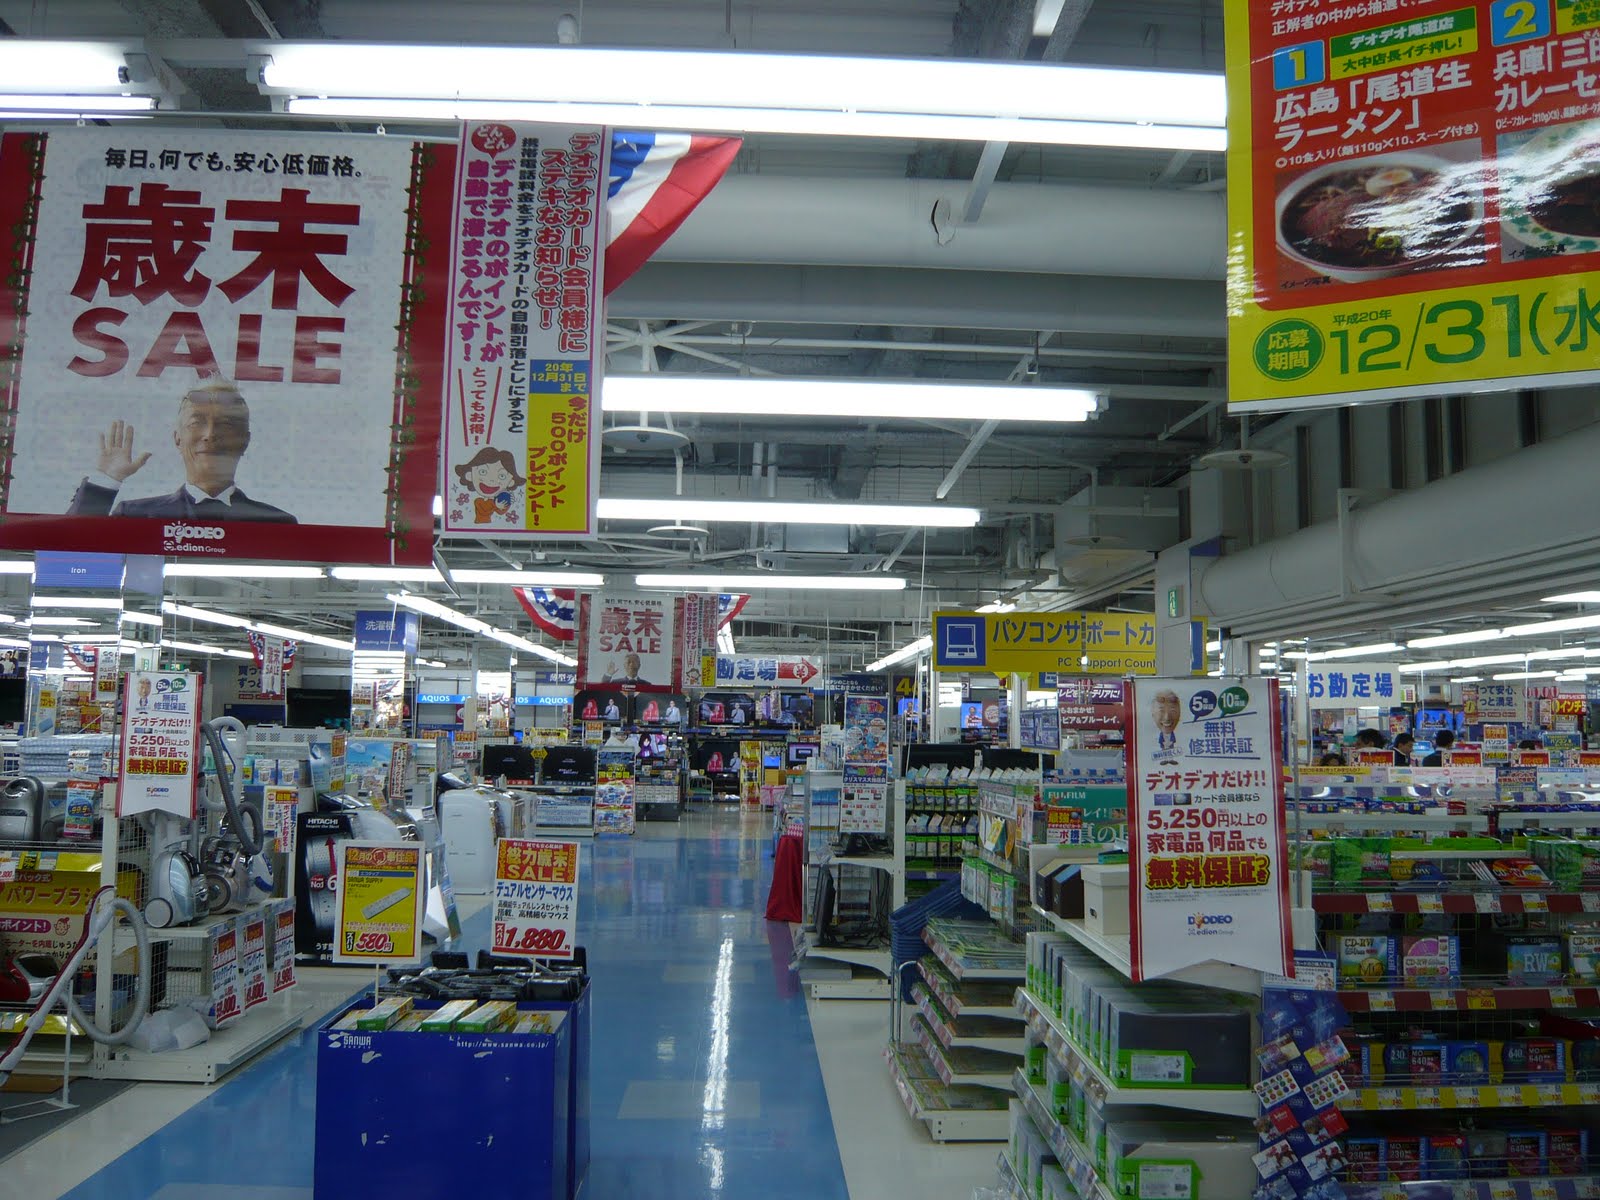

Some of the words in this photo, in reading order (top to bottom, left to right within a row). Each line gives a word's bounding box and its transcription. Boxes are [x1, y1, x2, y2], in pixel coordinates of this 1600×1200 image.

[1504, 1, 1537, 38] 2
[1350, 17, 1454, 50] デオデオ尾道店
[1289, 49, 1306, 81] 1
[1274, 61, 1472, 124] 広島「尾道生
[1495, 70, 1600, 112] カレーセ
[1275, 100, 1420, 152] ラーメン」
[70, 183, 361, 311] 歳末
[533, 149, 568, 330] ステキなお知らせ!
[559, 133, 599, 353] デオデオカード会員様に
[480, 159, 517, 363] デオデオのポイントが
[1332, 309, 1393, 327] 平成20年
[67, 307, 346, 385] SALE
[1267, 328, 1310, 350] 応募
[545, 363, 573, 373] 20年
[1267, 351, 1310, 371] 期間
[531, 372, 588, 383] 12月31日
[560, 383, 587, 392] まで
[469, 367, 487, 446] とってもお得!
[567, 396, 588, 443] 今だけ
[548, 412, 568, 508] 500ポイント
[528, 446, 548, 527] プレゼント!
[365, 620, 396, 631] 洗濯機
[599, 606, 663, 637] 歳末
[599, 636, 661, 653] SALE
[1058, 658, 1071, 667] PC
[1308, 672, 1393, 698] お勘定場
[131, 717, 192, 728] デオデオだけ!!
[1204, 721, 1236, 738] 無料
[1188, 738, 1253, 755] 修理保証
[1146, 770, 1266, 791] デオデオだけ!!
[1194, 793, 1260, 804] カード会員様なら
[1147, 832, 1203, 853] 家電品
[1207, 831, 1268, 852] 何品でも
[507, 865, 565, 882] SALE
[1146, 854, 1271, 890] 無料保証つき
[496, 881, 573, 901] デュアルセンサーマウス
[496, 924, 504, 946] ズバリ
[1388, 939, 1396, 971] maxell
[343, 1036, 371, 1046] SANWA
[457, 1040, 549, 1049] http://www.sanwa.co.jp/
